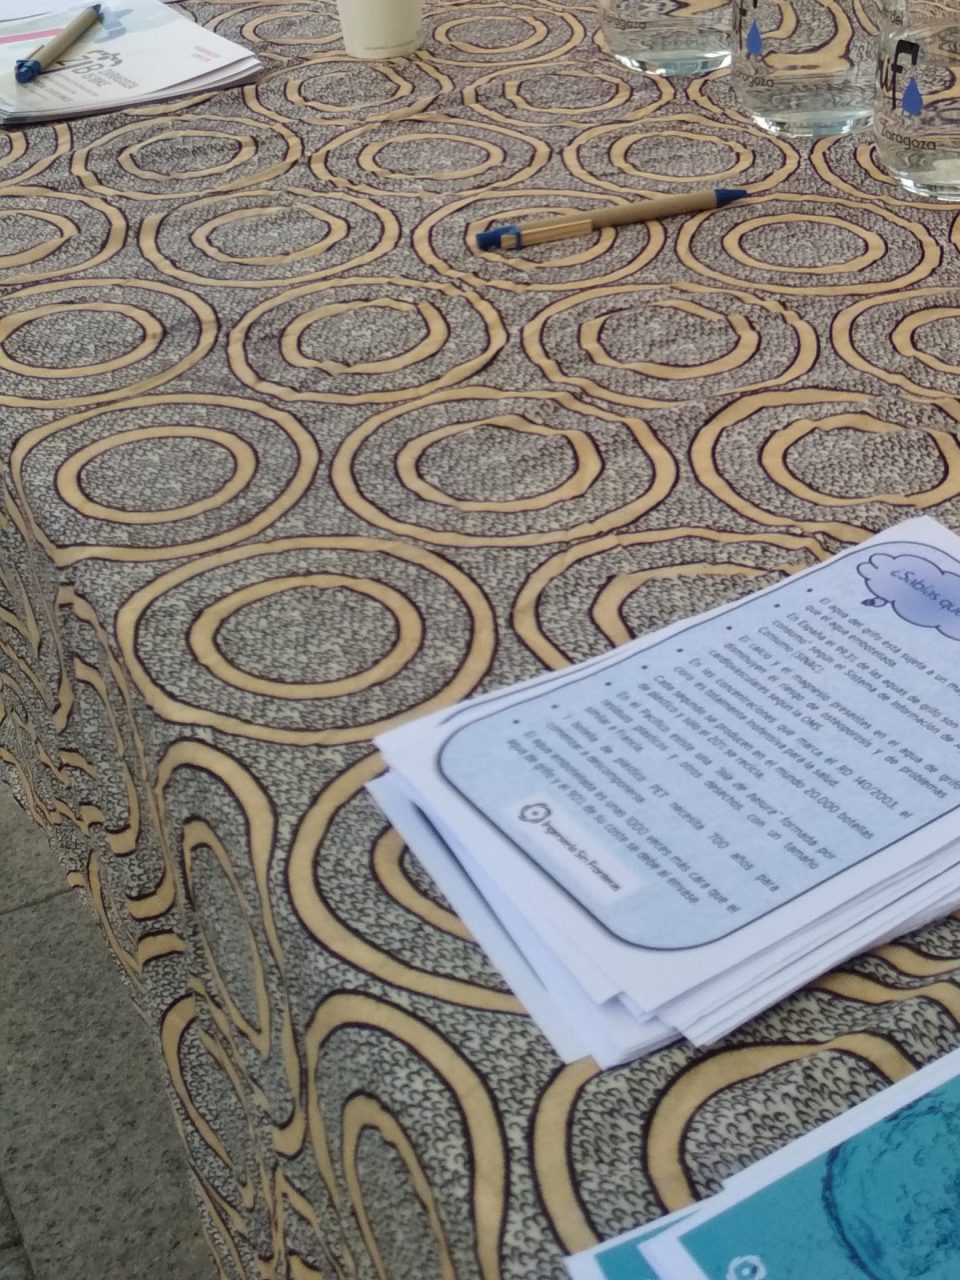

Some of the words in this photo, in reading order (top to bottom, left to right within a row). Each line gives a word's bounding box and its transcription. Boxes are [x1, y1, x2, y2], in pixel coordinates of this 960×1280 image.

[880, 120, 937, 151] Zaragoza
[886, 566, 951, 600] ¿Sabías
[824, 604, 850, 619] agua
[845, 617, 866, 628] del
[857, 626, 886, 642] grifo
[879, 639, 904, 653] está
[897, 652, 930, 670] sujeta
[933, 674, 949, 683] un
[537, 819, 582, 855] Ingeniería
[573, 849, 594, 863] Sin
[584, 859, 625, 892] Fronteras
